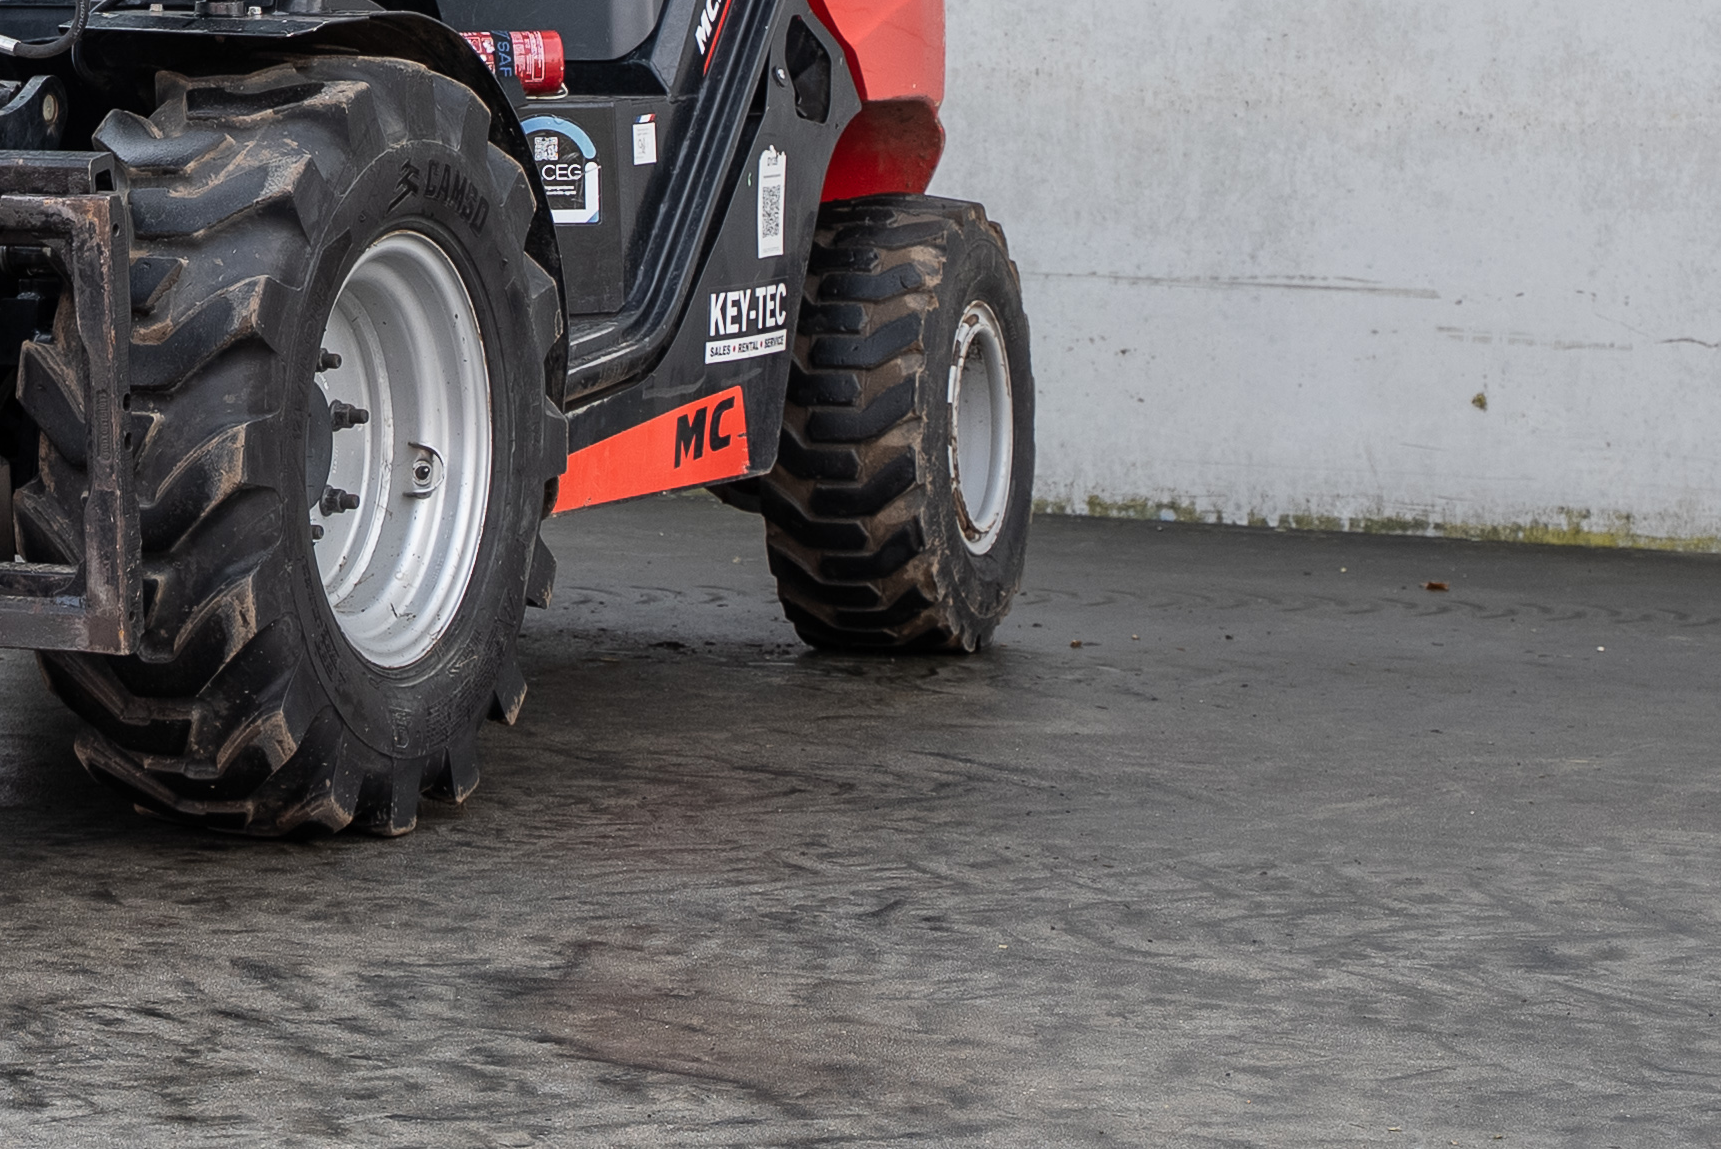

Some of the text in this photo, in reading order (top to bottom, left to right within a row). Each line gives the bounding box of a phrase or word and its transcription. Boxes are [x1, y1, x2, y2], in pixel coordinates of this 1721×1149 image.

[424, 159, 490, 238] CAMSO
[541, 164, 582, 181] CEG
[710, 283, 786, 336] KEY-TEC
[710, 336, 784, 357] SALES RENTAL SERVICE
[674, 396, 736, 469] MC
